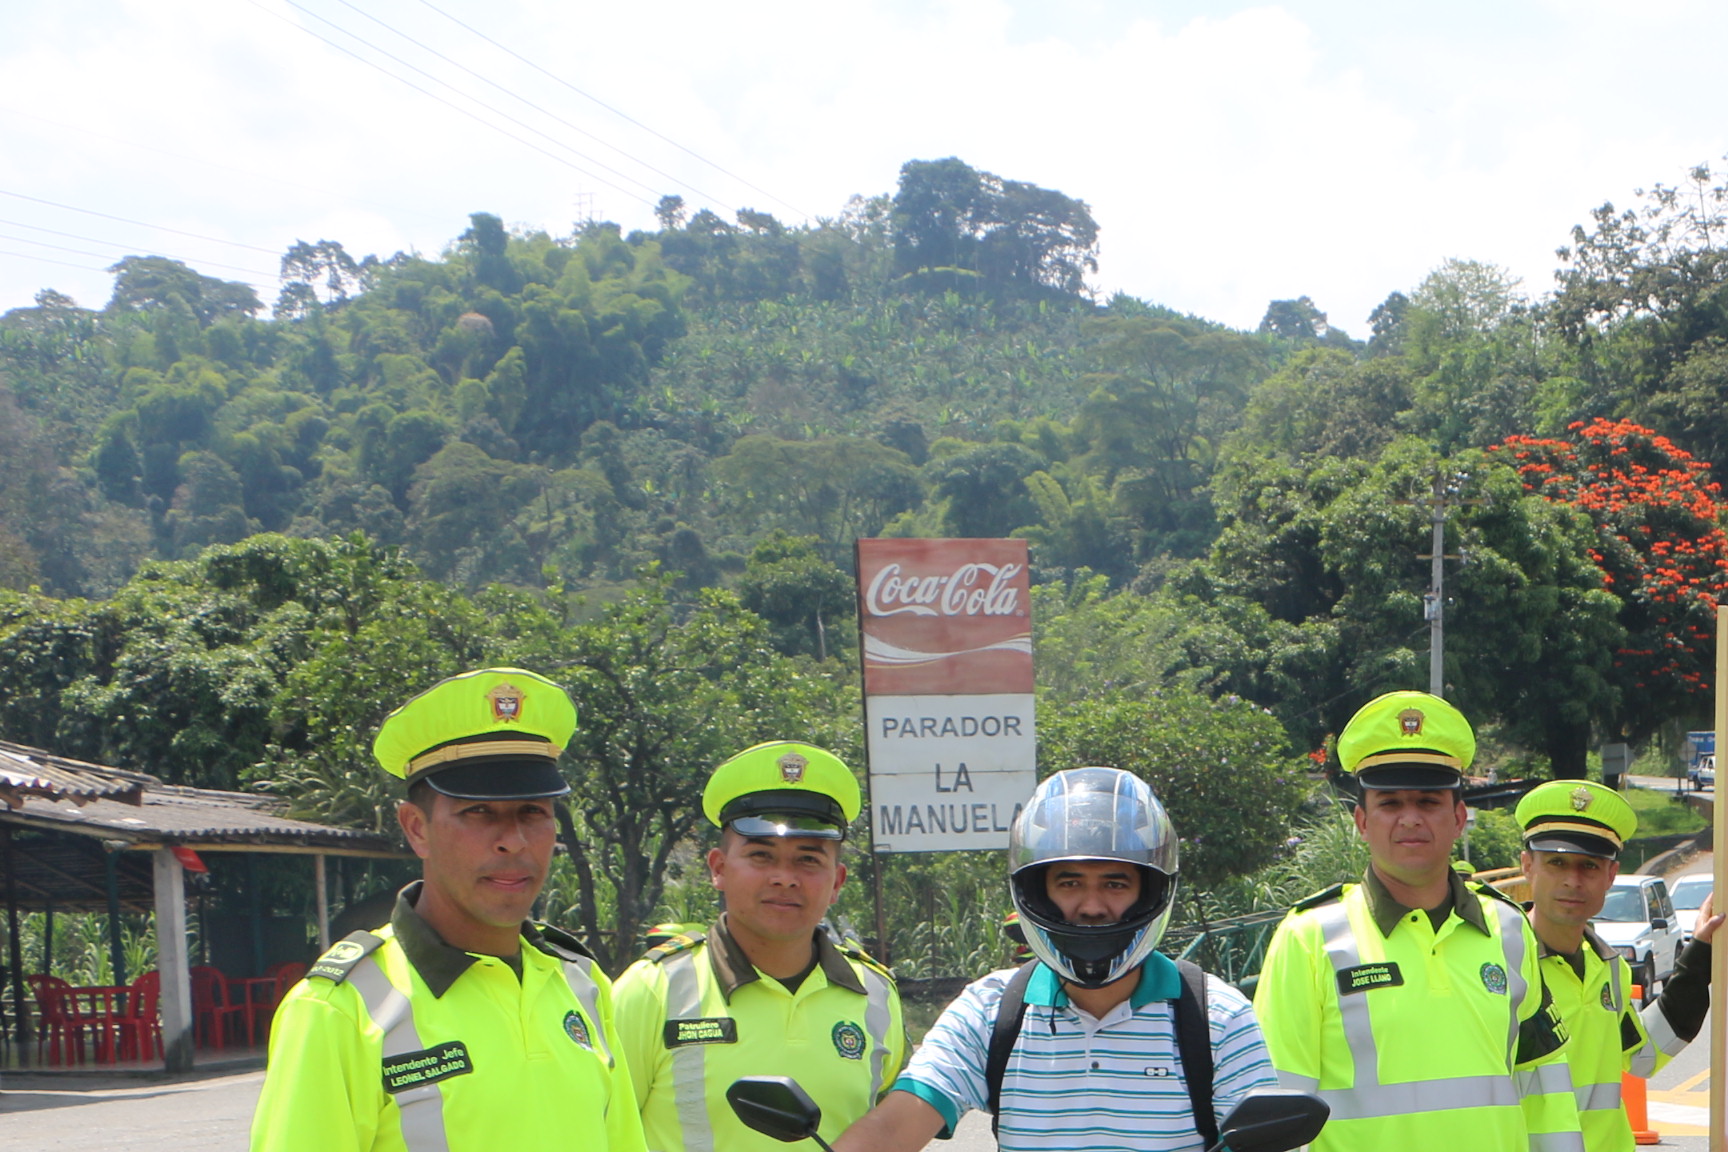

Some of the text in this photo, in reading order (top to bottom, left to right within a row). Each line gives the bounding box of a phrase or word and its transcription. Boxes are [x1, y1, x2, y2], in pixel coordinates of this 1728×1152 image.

[866, 562, 1023, 616] Coca-Cola
[882, 715, 1022, 738] PARADOR
[935, 762, 973, 793] LA
[1351, 976, 1370, 987] JOSE
[383, 1047, 465, 1077] Intendente Jefe
[390, 1059, 465, 1087] LEONEL SALGADO
